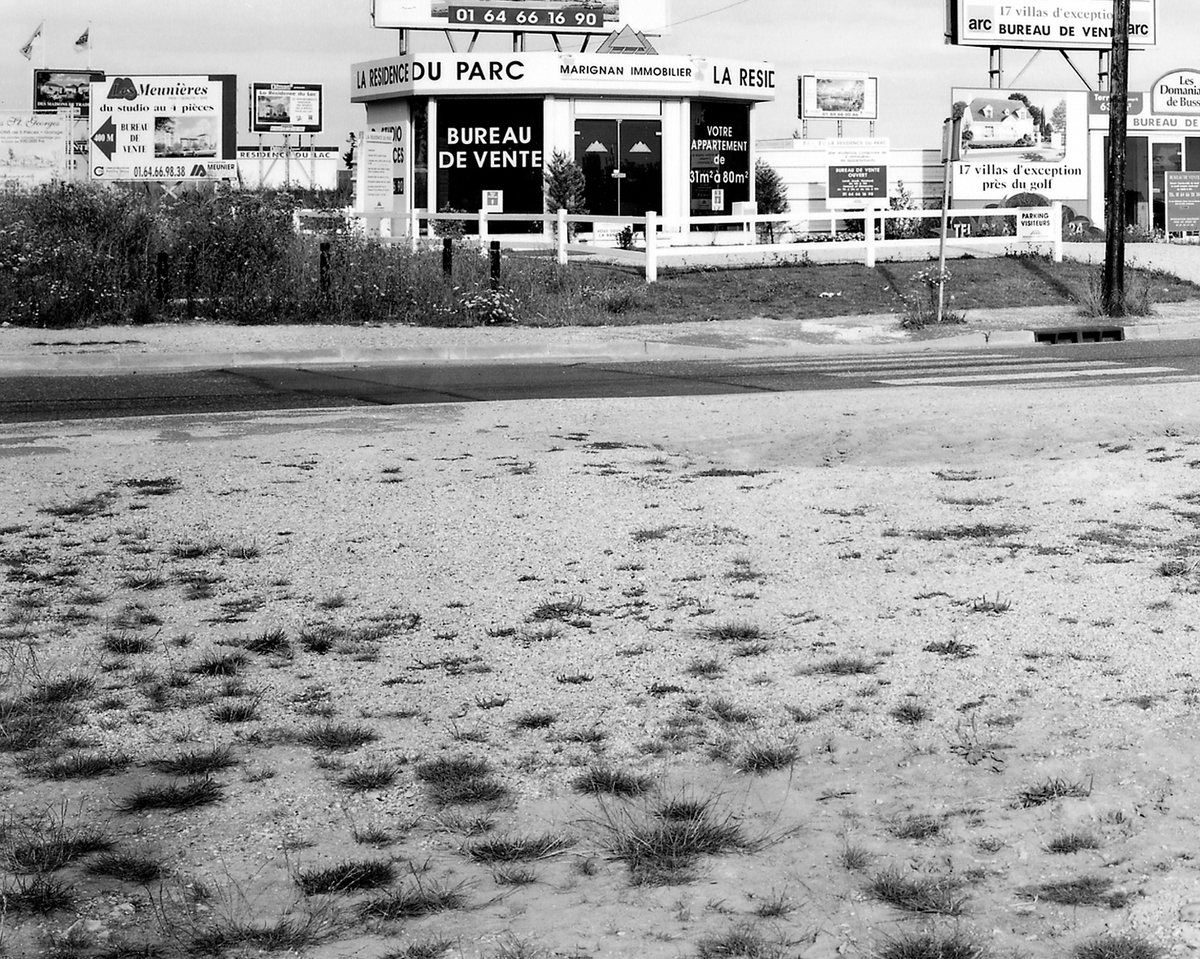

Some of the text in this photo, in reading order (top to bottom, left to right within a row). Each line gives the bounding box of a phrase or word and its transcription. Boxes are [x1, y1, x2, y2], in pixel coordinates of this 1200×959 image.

[456, 9, 597, 25] 01 64 66 16 90
[1000, 5, 1114, 21] 17 villas d'exceptio
[968, 17, 992, 31] arc
[999, 24, 1114, 38] BUREAU DE VENT
[357, 61, 525, 89] LA RESIDENCE DU PARC
[560, 65, 692, 77] MARIGNAN IMMOBILIER
[713, 66, 732, 85] LA
[1179, 76, 1194, 85] Les
[139, 82, 208, 96] Meunières
[1166, 96, 1178, 107] de
[100, 104, 113, 112] du
[117, 104, 149, 112] studio
[182, 103, 214, 113] pièces
[121, 123, 148, 131] BUREAU
[1133, 118, 1177, 127] BUREAU
[1185, 119, 1198, 127] DE
[448, 127, 531, 145] BUREAU
[707, 125, 732, 137] VOTRE
[130, 134, 139, 142] DE
[123, 145, 146, 153] VENTE
[691, 139, 747, 151] APPARTEMENT
[439, 150, 542, 168] DE VENTE
[713, 154, 725, 165] de
[133, 166, 186, 177] 01.64.66.98.38
[714, 170, 721, 183] à
[723, 170, 748, 183] 80m²
[959, 164, 1082, 180] 17 villas d'exception
[983, 179, 1052, 191] près du golf
[1021, 219, 1050, 227] VISITEURS
